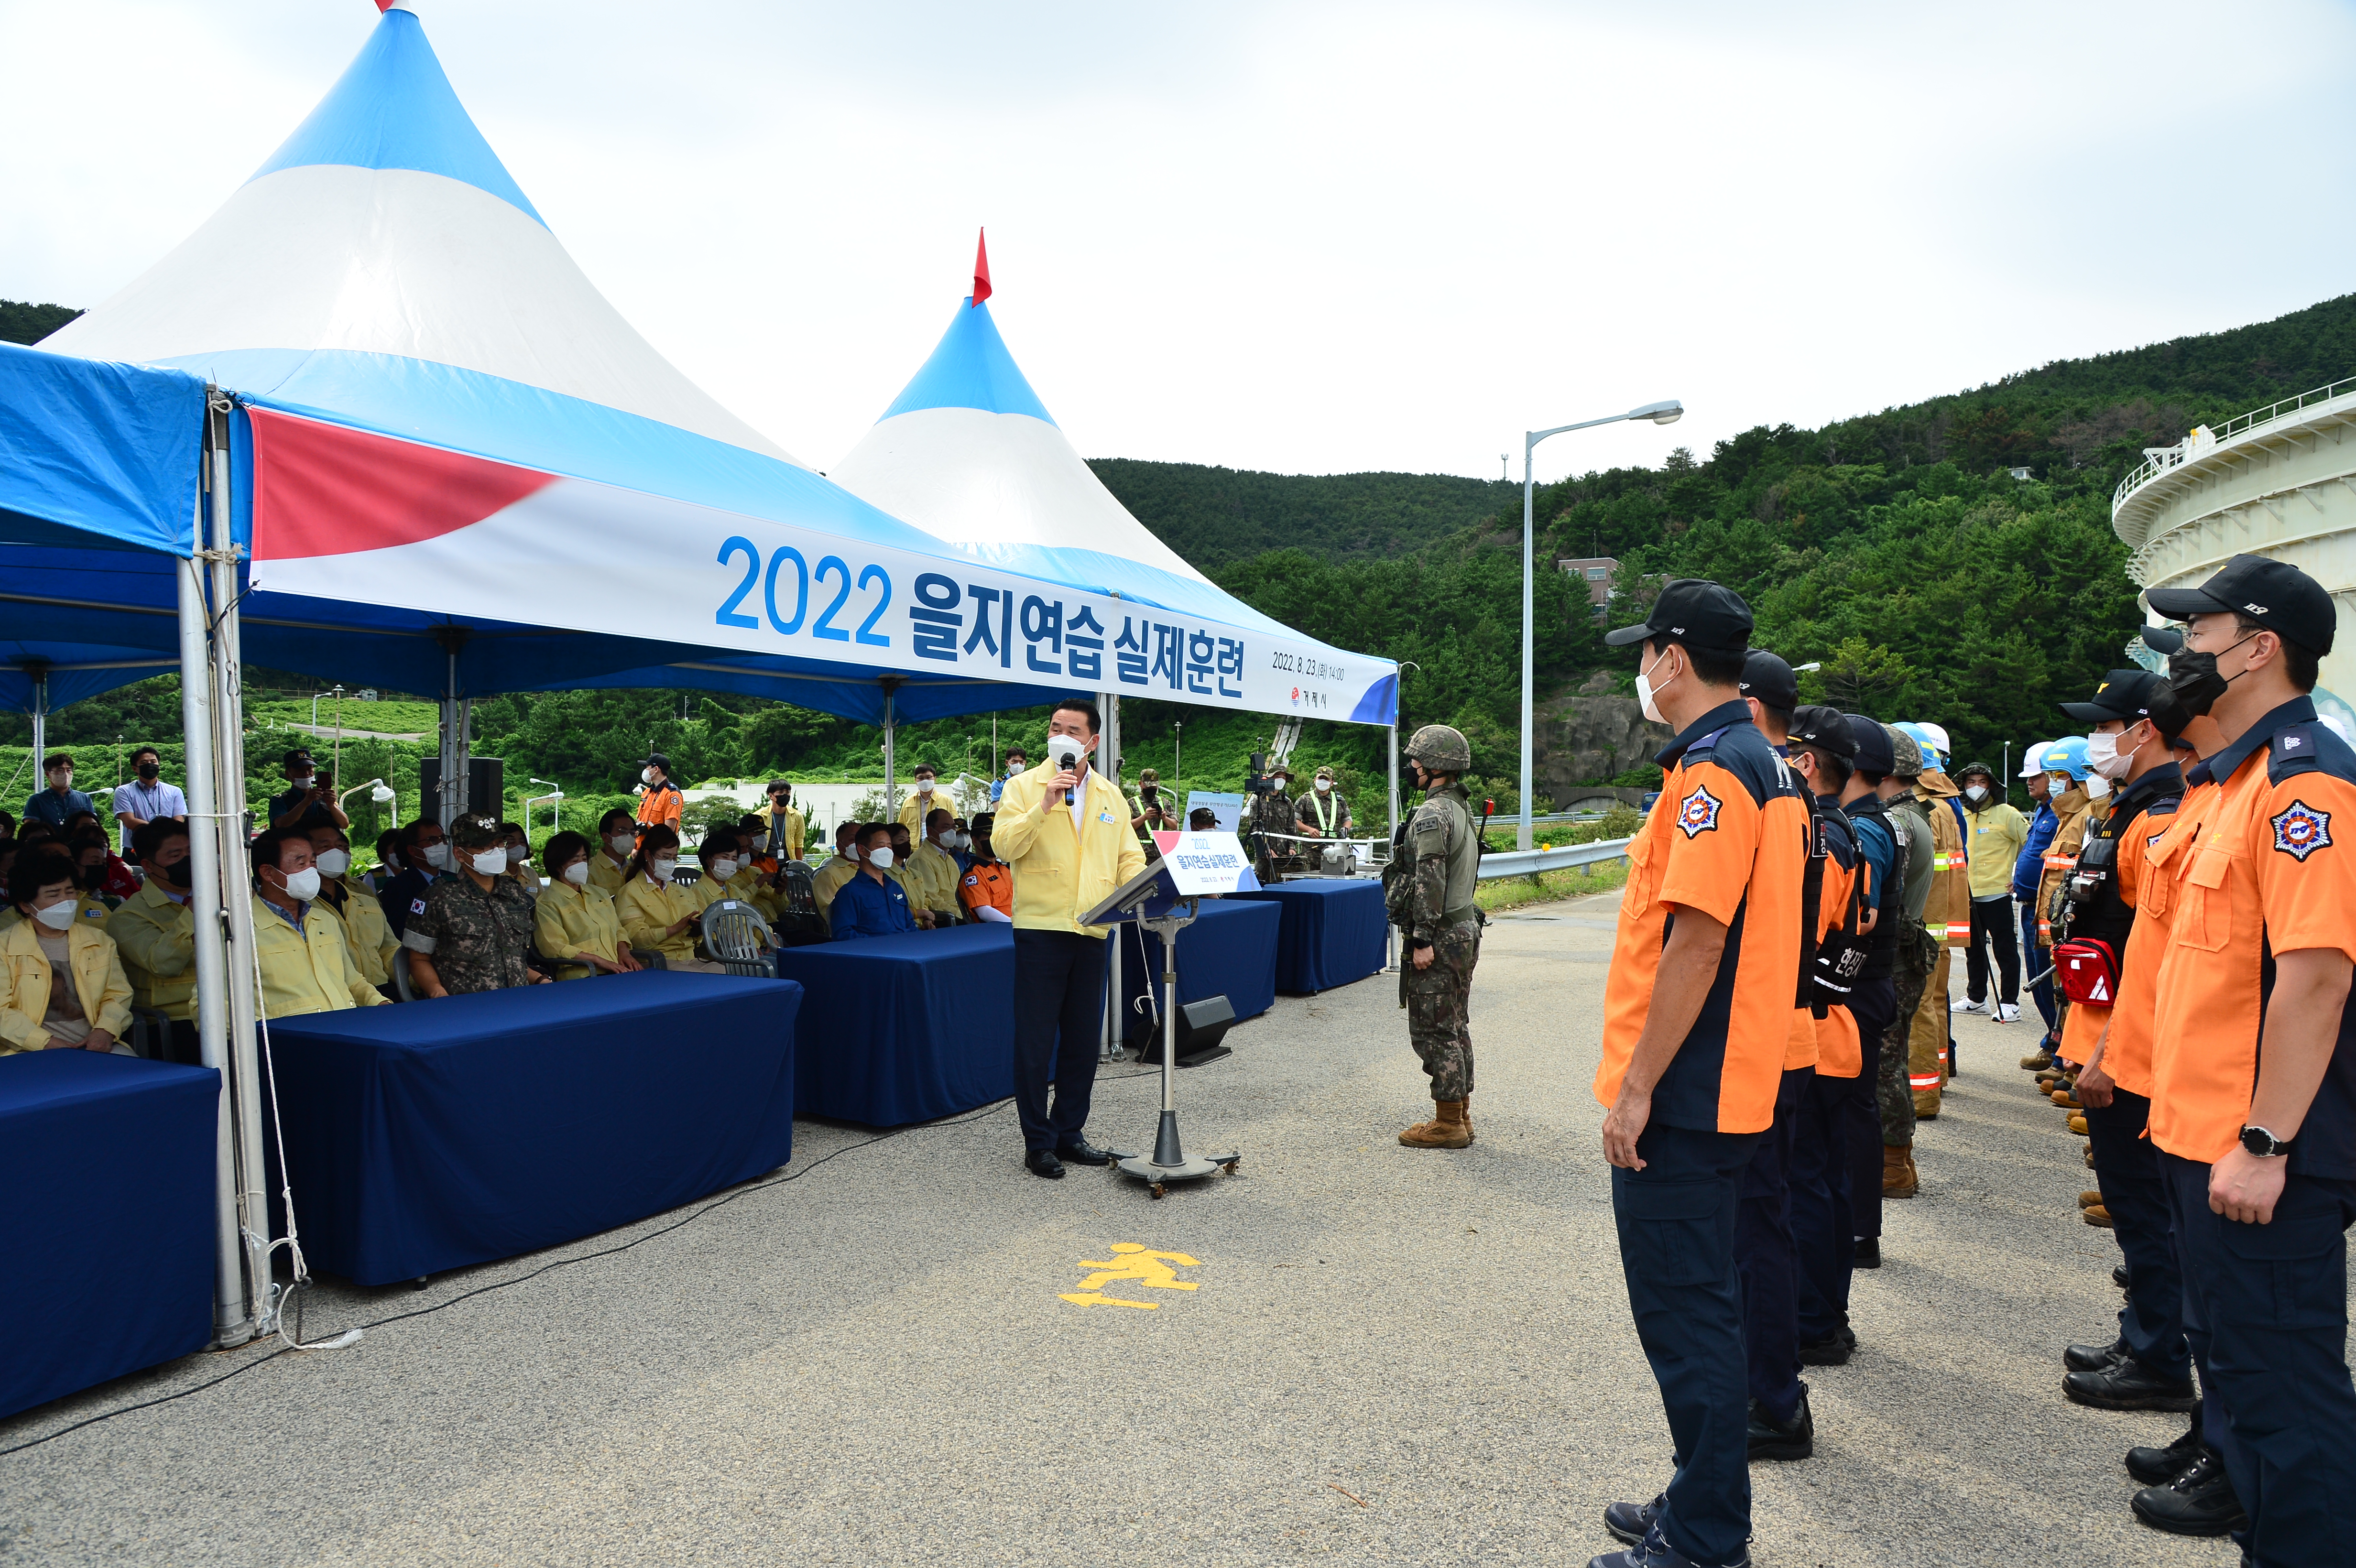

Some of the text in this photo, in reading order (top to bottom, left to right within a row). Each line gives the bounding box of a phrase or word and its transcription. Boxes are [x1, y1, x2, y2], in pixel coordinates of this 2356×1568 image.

[716, 535, 1244, 698] 2022 을지연습 실제훈련
[1329, 666, 1344, 681] 14:00
[1191, 838, 1211, 849] 2022
